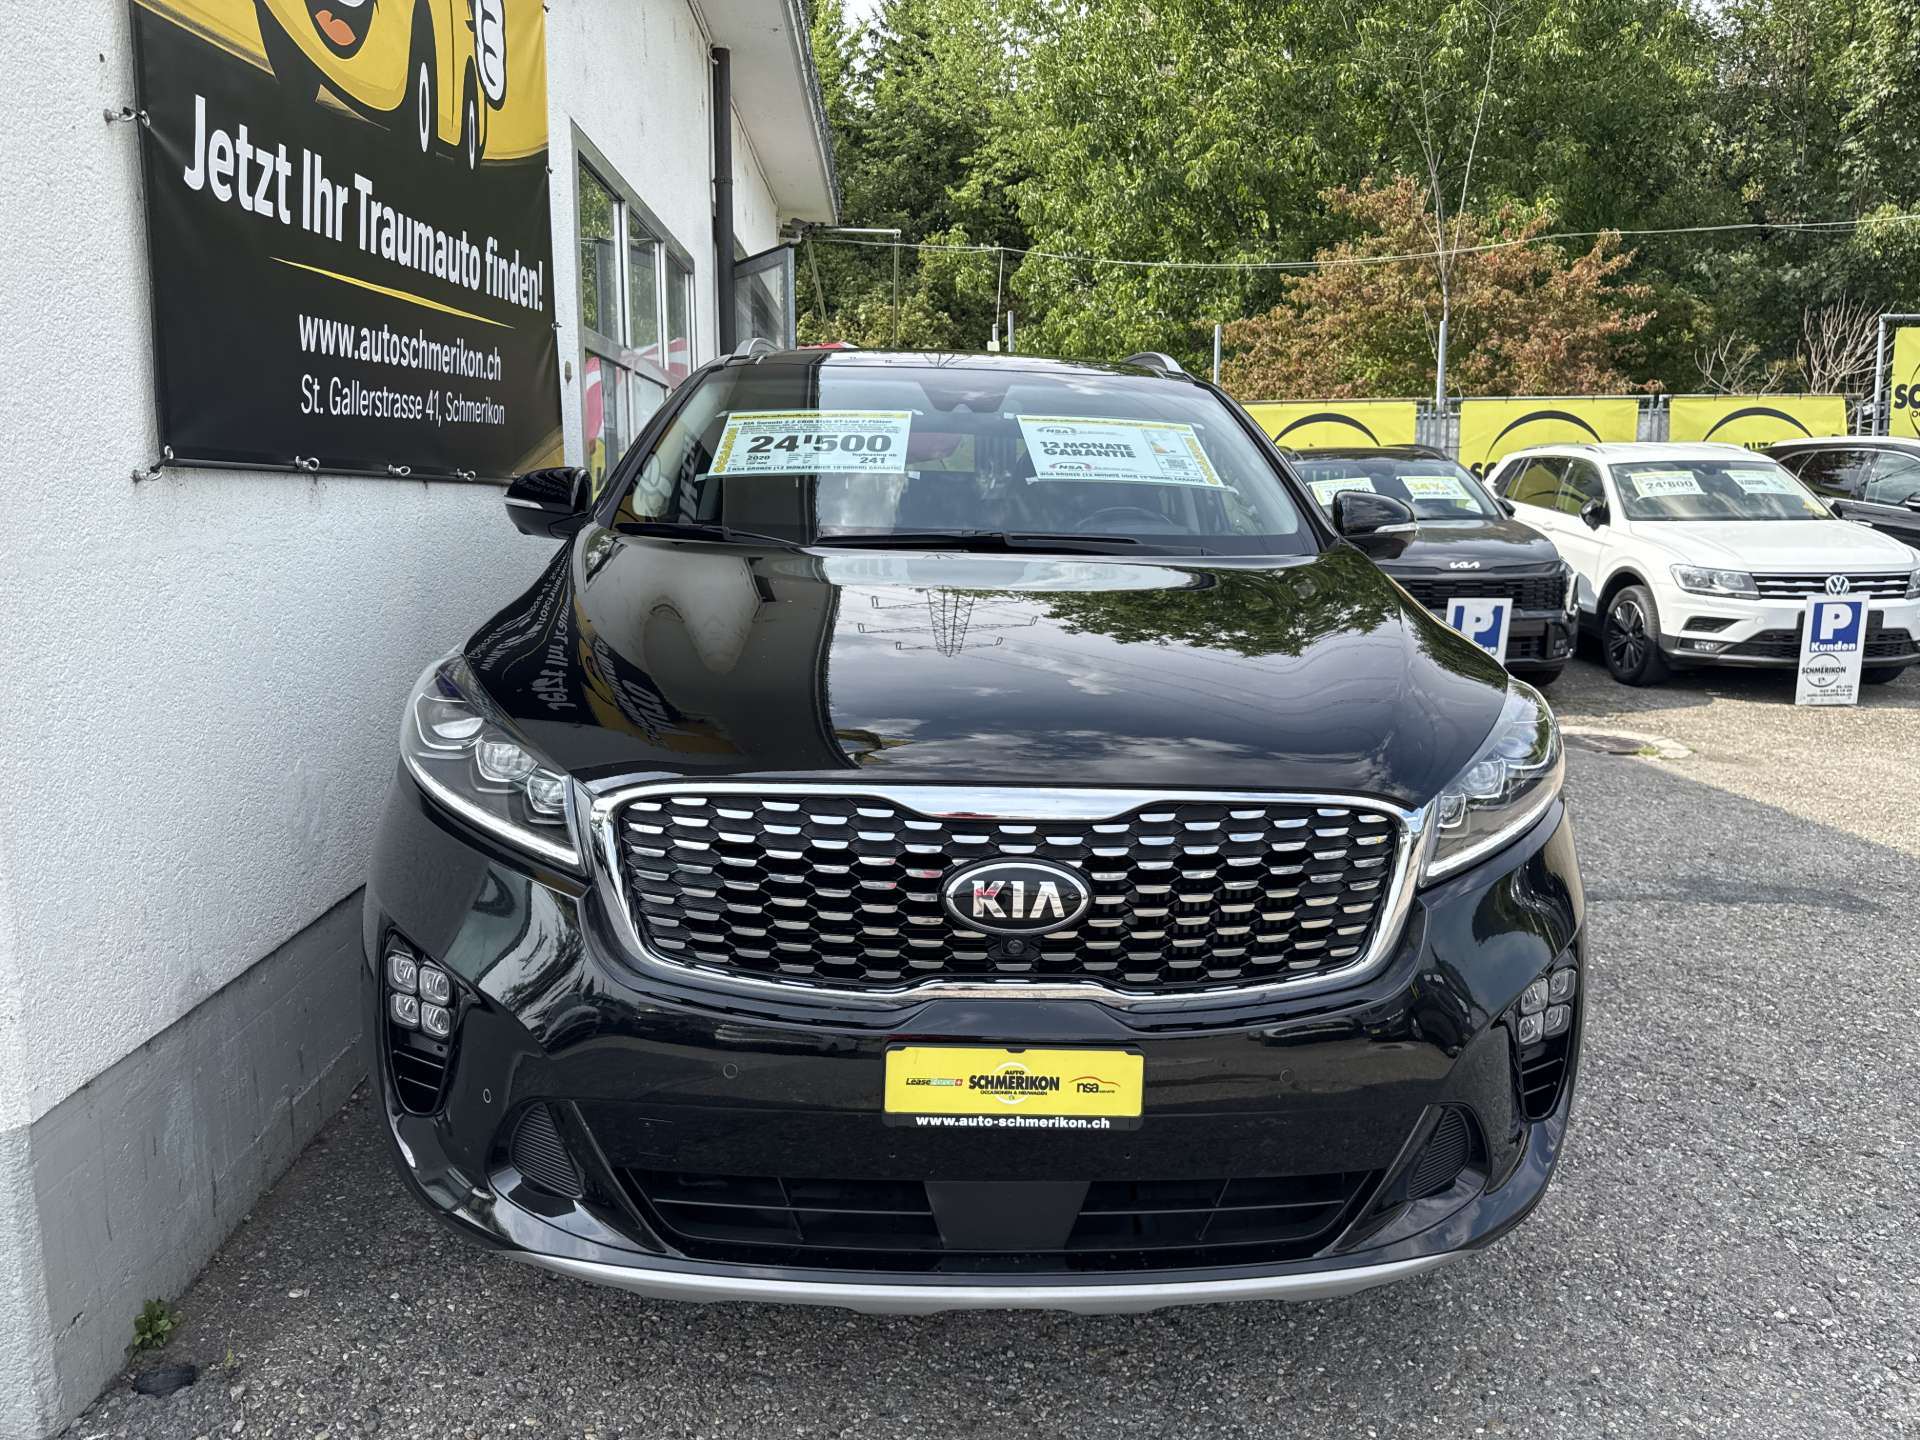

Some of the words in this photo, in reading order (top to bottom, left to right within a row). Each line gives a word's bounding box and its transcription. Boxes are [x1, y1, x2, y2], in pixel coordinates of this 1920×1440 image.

[183, 94, 292, 225] Jetzt
[302, 148, 348, 243] Ihr
[354, 173, 481, 291] Traumauto
[485, 236, 544, 313] finden!
[299, 314, 502, 382] www.autoschmerikon.ch
[300, 374, 324, 415] St.
[329, 377, 424, 422] Gallerstrasse
[425, 391, 442, 428] 41,
[445, 393, 505, 426] Schmerikon
[747, 434, 892, 453] 24'500
[1063, 442, 1132, 450] MONATE
[1043, 449, 1137, 458] GARANTIE
[1820, 603, 1853, 640] P
[1810, 641, 1856, 652] Kunden
[1801, 666, 1847, 674] SCHMERIKON
[972, 880, 1065, 919] KIA
[968, 1075, 1060, 1091] SCHMERIKON
[1077, 1082, 1099, 1093] nsa
[915, 1115, 1110, 1129] www.auto-schmerikon.ch
